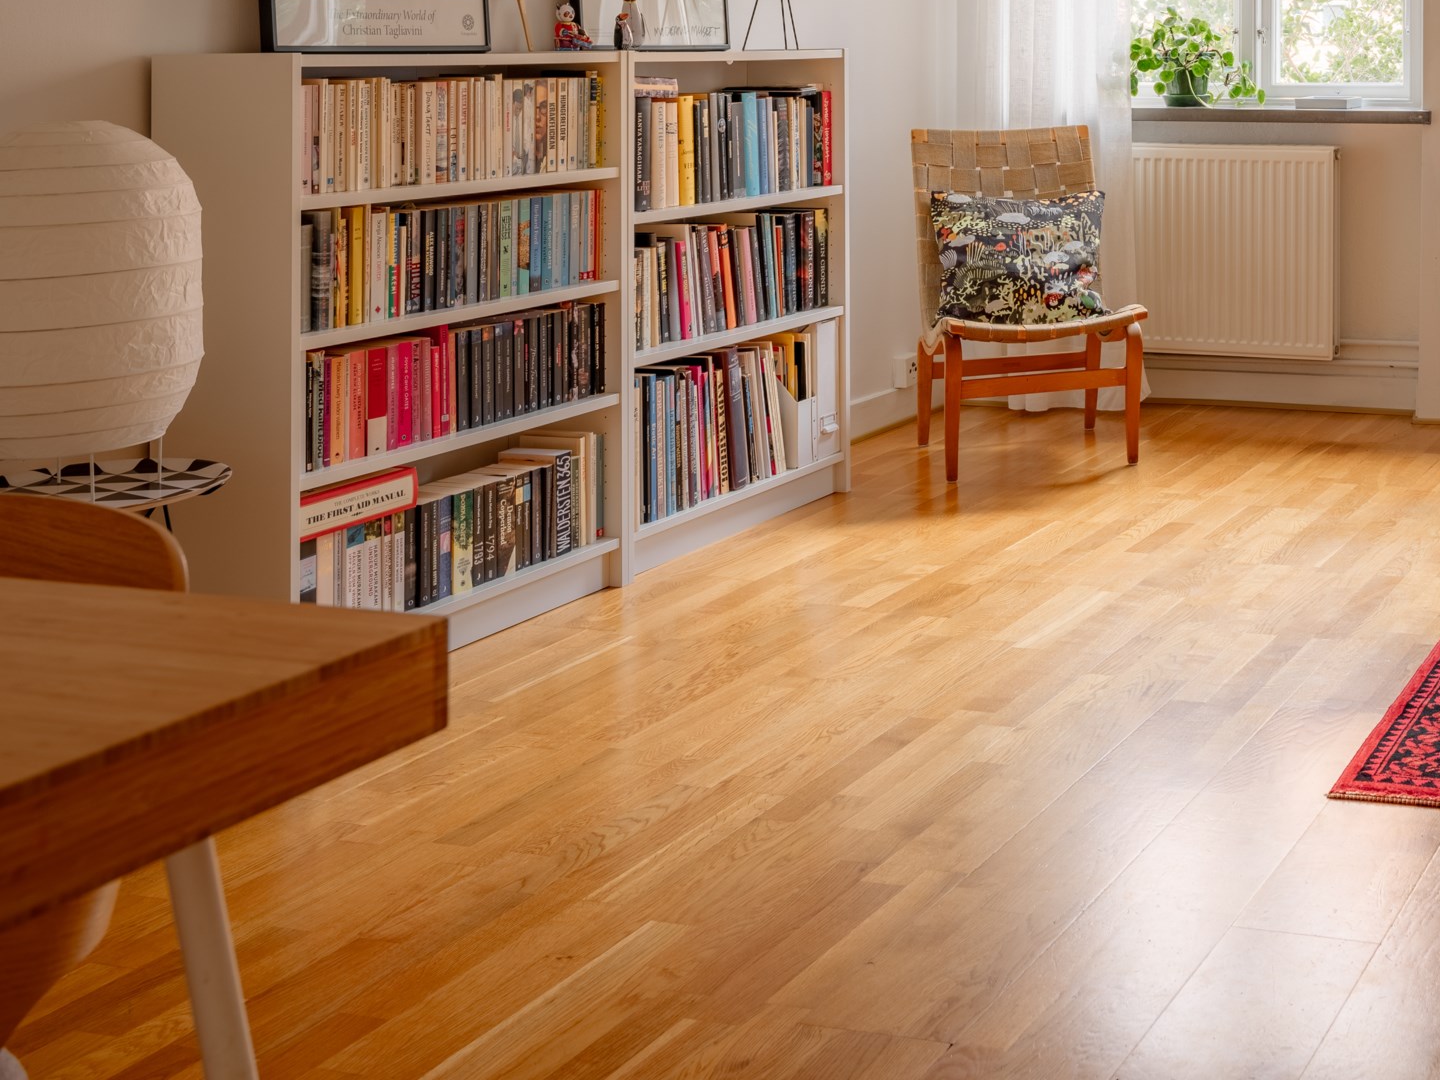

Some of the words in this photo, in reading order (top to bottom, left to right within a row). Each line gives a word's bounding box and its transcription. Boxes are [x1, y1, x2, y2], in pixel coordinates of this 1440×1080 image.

[342, 24, 382, 37] Christian
[384, 24, 423, 39] Tagliavini
[345, 8, 402, 23] Extraordinary
[403, 9, 427, 21] World
[428, 9, 437, 24] of
[411, 262, 421, 300] HILMA
[717, 381, 725, 415] ANDY
[557, 455, 571, 479] 365
[306, 512, 326, 526] THE
[326, 505, 355, 521] FIRST
[356, 498, 371, 512] AID
[371, 489, 406, 507] MANUAL
[499, 498, 507, 545] Copperhead
[557, 480, 571, 553] WALDERSTEN
[474, 541, 484, 566] 1793
[485, 533, 495, 561] 1794
